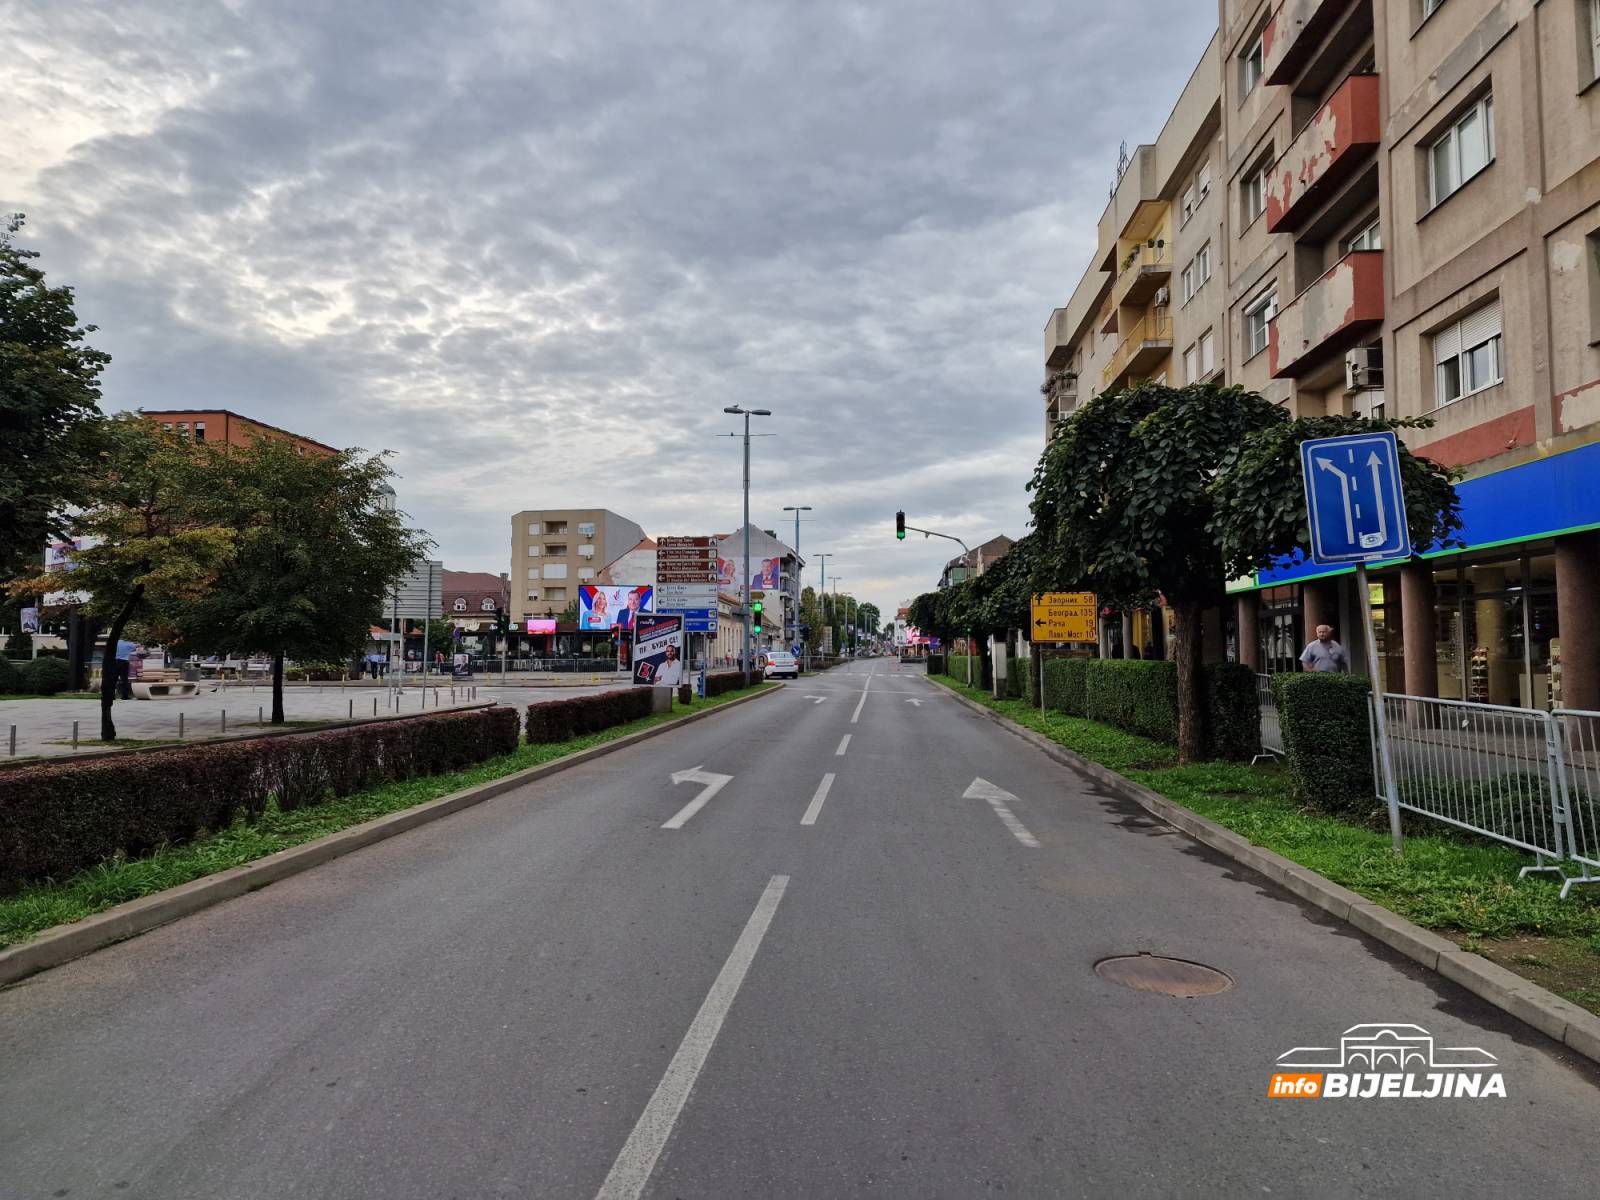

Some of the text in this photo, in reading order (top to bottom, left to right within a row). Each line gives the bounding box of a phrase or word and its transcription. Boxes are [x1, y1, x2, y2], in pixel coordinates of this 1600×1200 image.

[1083, 595, 1094, 604] 58
[1048, 608, 1093, 618] Београд 135
[1085, 619, 1094, 627] 19
[1086, 630, 1094, 639] 10
